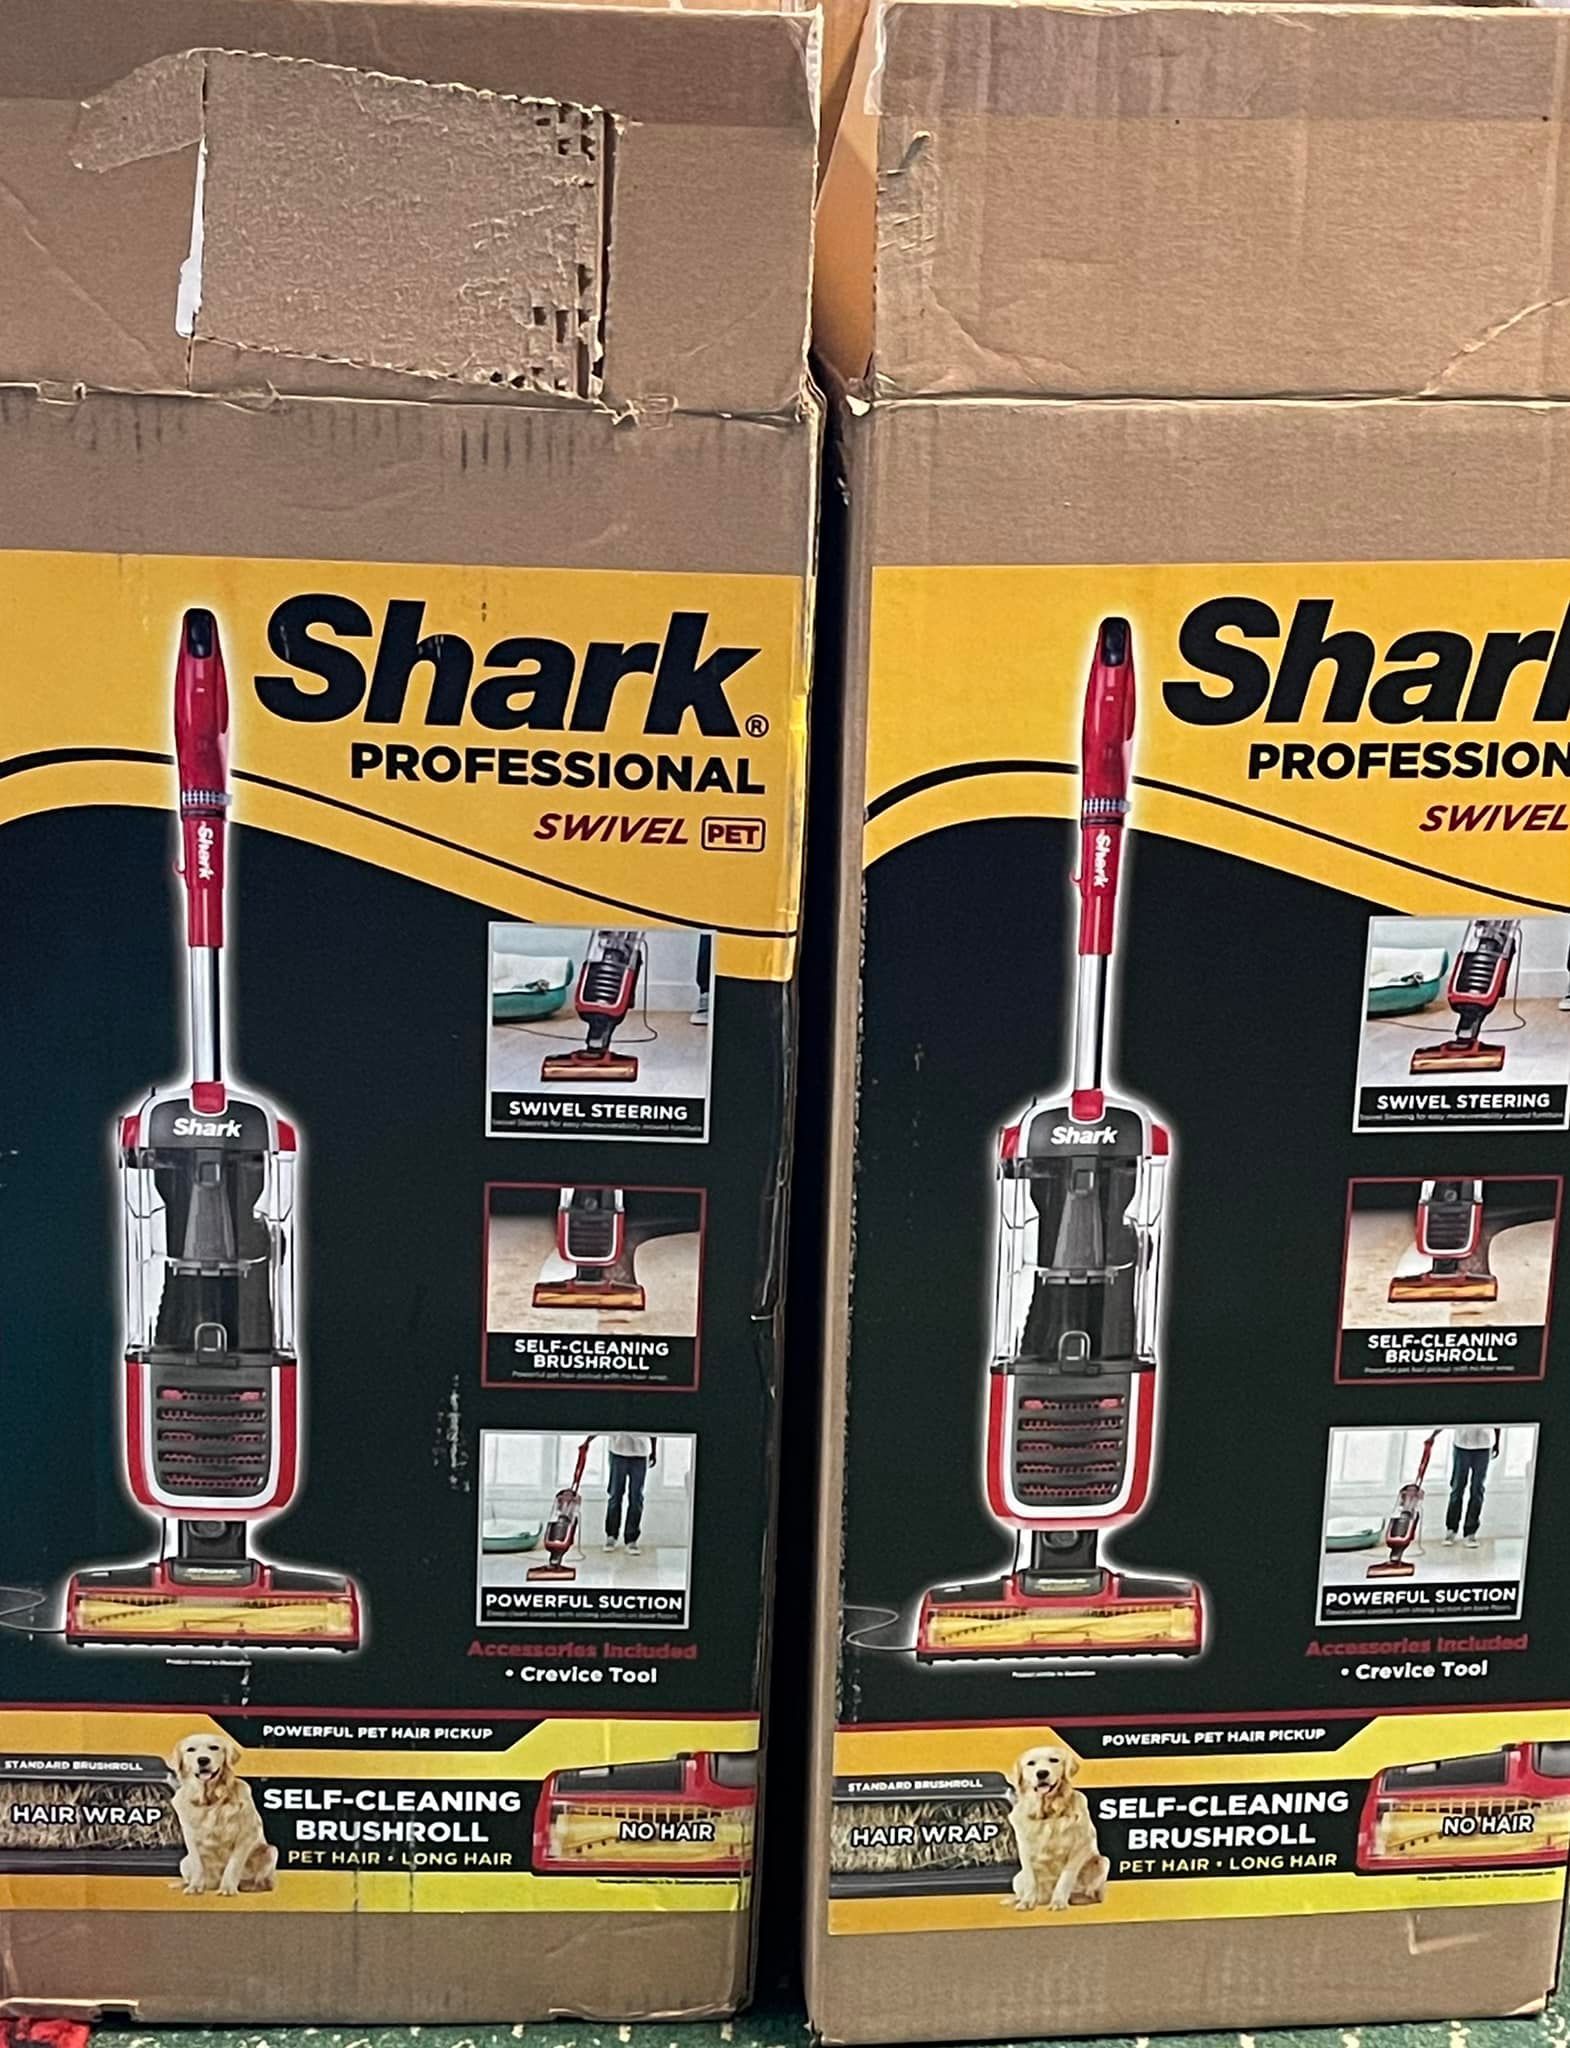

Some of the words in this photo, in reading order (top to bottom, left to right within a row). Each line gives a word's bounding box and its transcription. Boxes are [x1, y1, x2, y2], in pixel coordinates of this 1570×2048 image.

[351, 744, 765, 794] PROFESSIONAL
[1248, 742, 1570, 780] PROFESSION
[1419, 804, 1569, 832] SWIVEL
[534, 813, 689, 844] SWIVEL
[708, 824, 759, 844] PET
[197, 821, 214, 880] Shark
[509, 1101, 586, 1117] SWIVEL
[591, 1104, 688, 1120] STEERING
[1377, 1095, 1451, 1109] SWIVEL
[1457, 1093, 1551, 1108] STEERING
[173, 1118, 242, 1137] Shark
[1050, 1126, 1118, 1144] Shark
[514, 1339, 669, 1356] SELF-CLEANING
[1367, 1332, 1518, 1349] SELF-CLEANING
[533, 1354, 650, 1370] BRUSHROLL
[1385, 1348, 1498, 1363] BRUSHROLL
[486, 1594, 593, 1608] POWERFUL
[599, 1595, 682, 1610] SUCTION
[1325, 1591, 1430, 1606] POWERFUL
[1435, 1587, 1517, 1604] SUCTION
[467, 1640, 597, 1657] Accessories
[604, 1642, 698, 1659] Included
[1305, 1637, 1431, 1656] Accessories
[1437, 1633, 1529, 1652] Included
[520, 1666, 603, 1682] Crevice
[609, 1667, 658, 1683] Tool
[1355, 1662, 1435, 1680] Crevice
[1441, 1659, 1488, 1677] Tool
[263, 1725, 354, 1738] POWERFUL
[358, 1726, 388, 1739] PET
[391, 1727, 430, 1739] HAIR
[434, 1727, 493, 1740] PICKUP
[1102, 1732, 1190, 1746] POWERFUL
[1194, 1731, 1224, 1744] PET
[1227, 1730, 1265, 1743] HAIR
[1269, 1728, 1326, 1741] PICKUP
[4, 1760, 70, 1770] STANDARD
[73, 1761, 143, 1771] BRUSHROLL
[848, 1780, 911, 1792] STANDARD
[914, 1779, 983, 1790] BRUSHROLL
[263, 1788, 521, 1812] SELF-CLEANING
[1098, 1791, 1349, 1820] SELF-CLEANING
[12, 1805, 75, 1823] HAIR
[82, 1806, 162, 1825] WRAP
[295, 1819, 489, 1843] BRUSHROLL
[620, 1823, 654, 1840] NO
[660, 1823, 714, 1841] HAIR
[852, 1827, 914, 1846] HAIR
[921, 1824, 999, 1843] WRAP
[1444, 1818, 1476, 1835] NO
[1482, 1816, 1533, 1833] HAIR
[1127, 1823, 1316, 1850] BRUSHROLL
[288, 1851, 326, 1864] PET
[332, 1851, 380, 1865] HAIR
[401, 1852, 458, 1866] LONG
[464, 1852, 512, 1866] HAIR
[1119, 1860, 1156, 1874] PET
[1161, 1858, 1209, 1872] HAIR
[1229, 1855, 1284, 1870] LONG
[1290, 1853, 1338, 1868] HAIR
